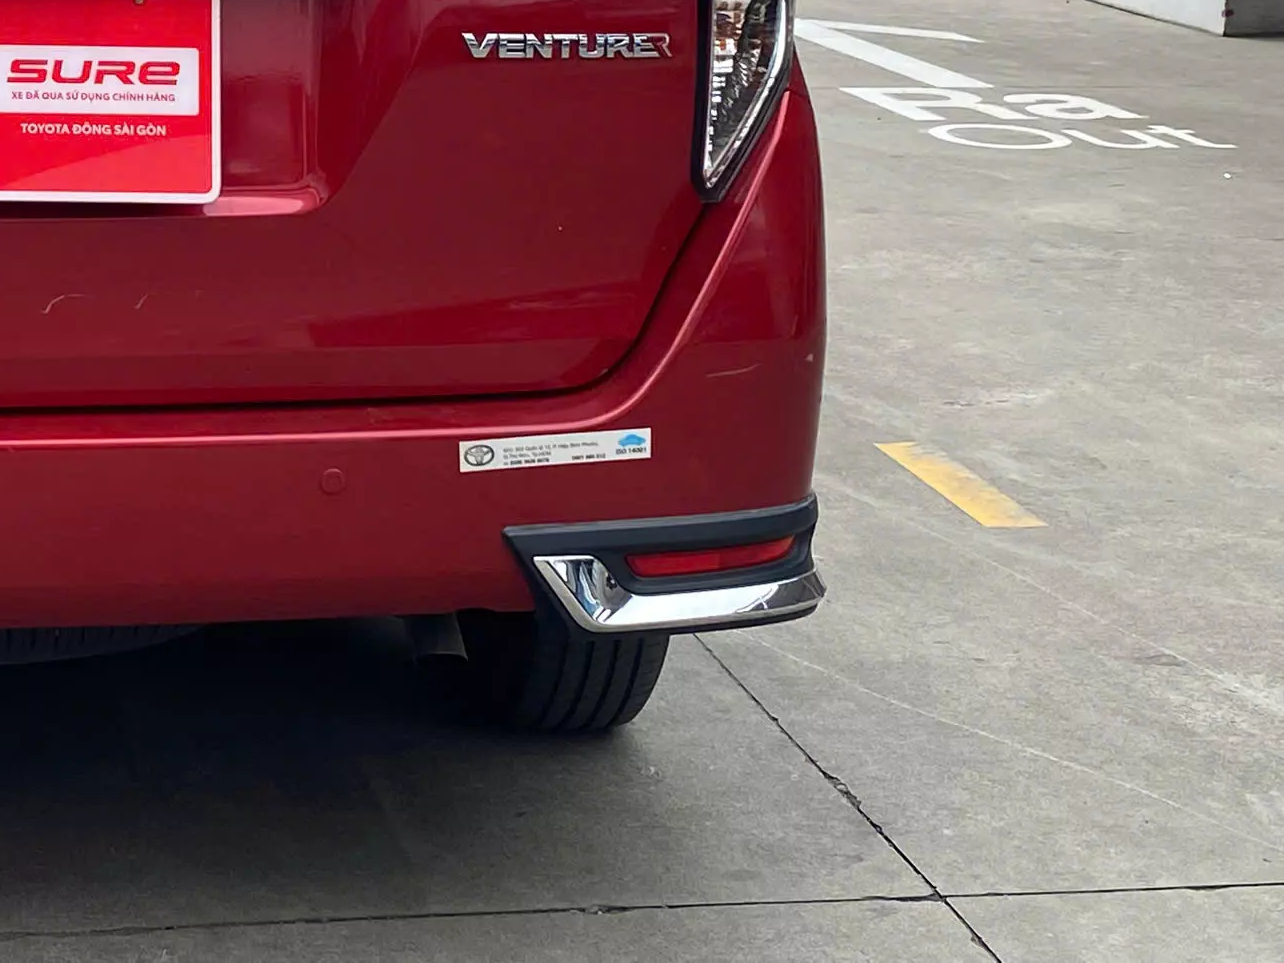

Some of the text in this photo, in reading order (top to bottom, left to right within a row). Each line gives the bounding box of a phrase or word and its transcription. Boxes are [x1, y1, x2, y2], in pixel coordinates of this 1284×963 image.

[461, 32, 673, 59] VENTURER
[12, 92, 23, 100] XE
[42, 92, 63, 101] QUA
[81, 93, 110, 104] DỤNG
[112, 92, 144, 102] CHÍNH
[839, 87, 1149, 121] Ra
[20, 120, 167, 136] TOYOTA ĐÔNG SÀI GÒN
[923, 123, 1239, 150] Out
